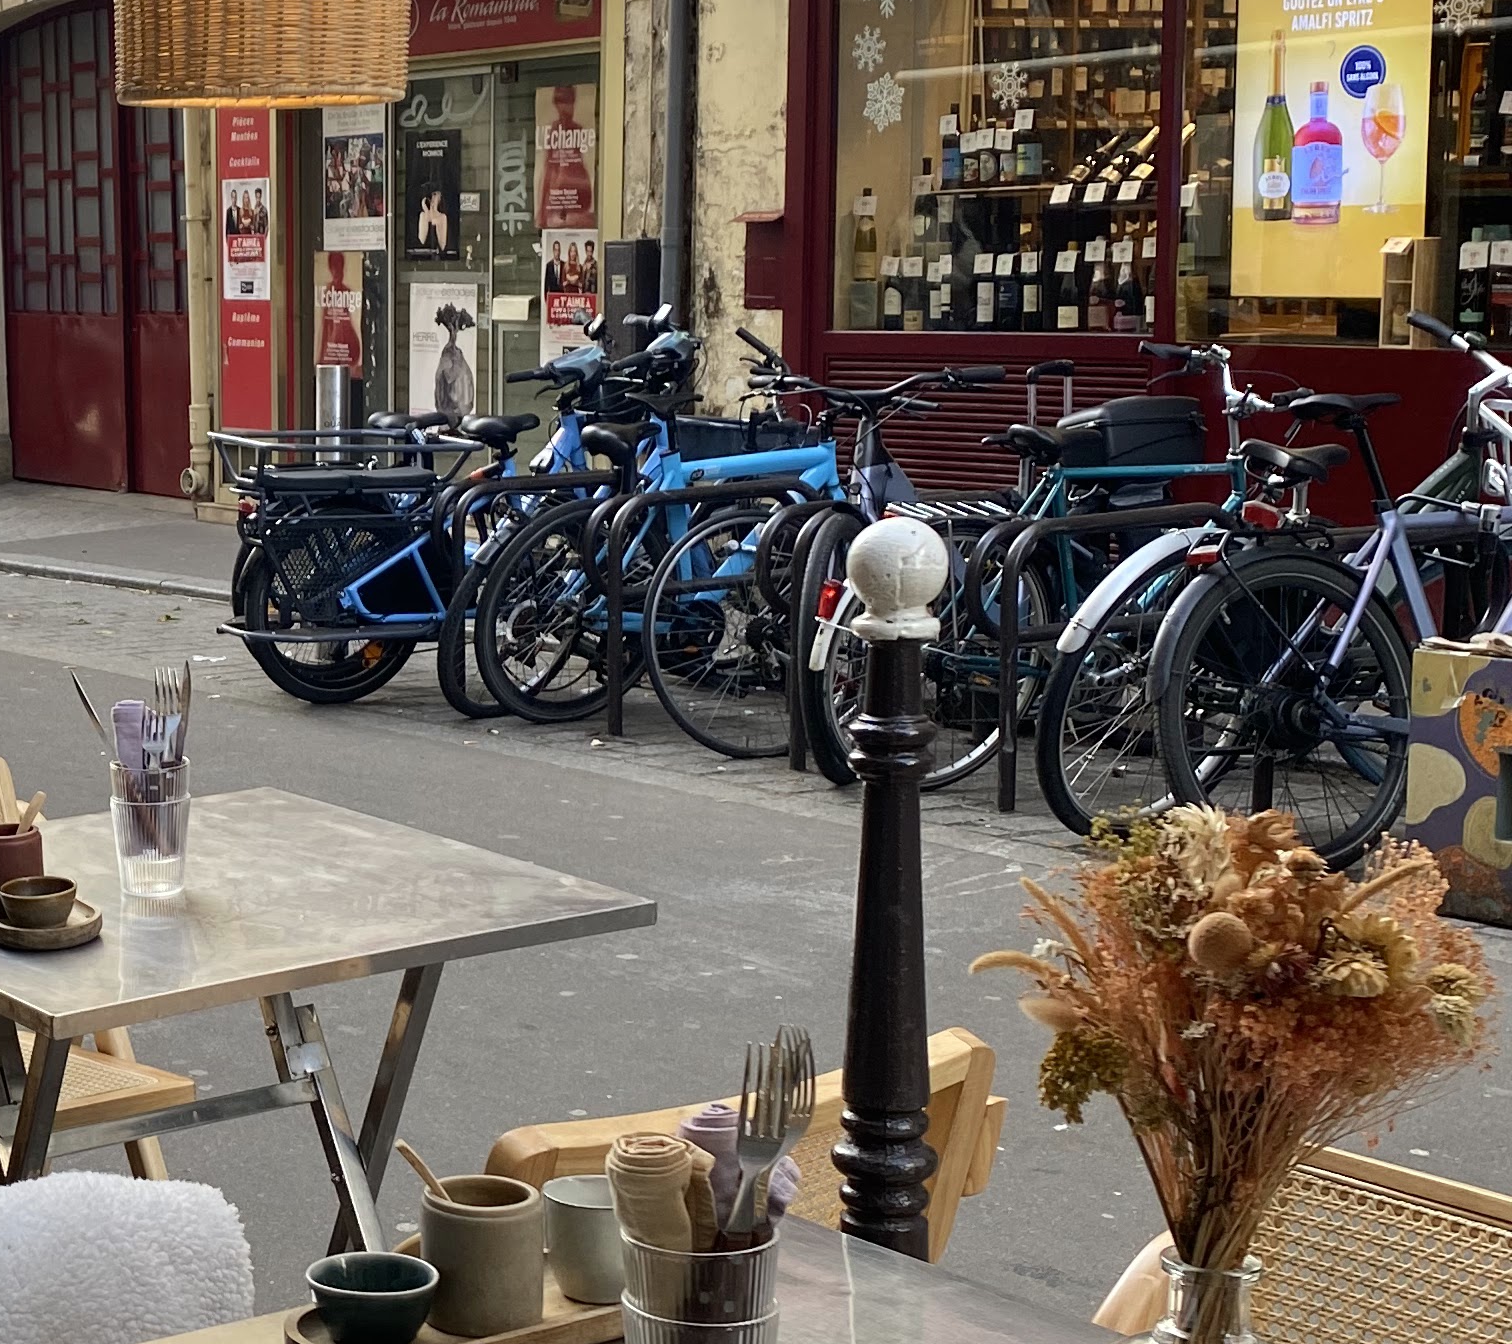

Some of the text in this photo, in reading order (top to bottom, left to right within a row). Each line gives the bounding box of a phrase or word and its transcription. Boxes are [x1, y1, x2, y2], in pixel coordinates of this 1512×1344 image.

[1291, 8, 1374, 32] AMALFI SPRITZ
[227, 336, 265, 348] Communion
